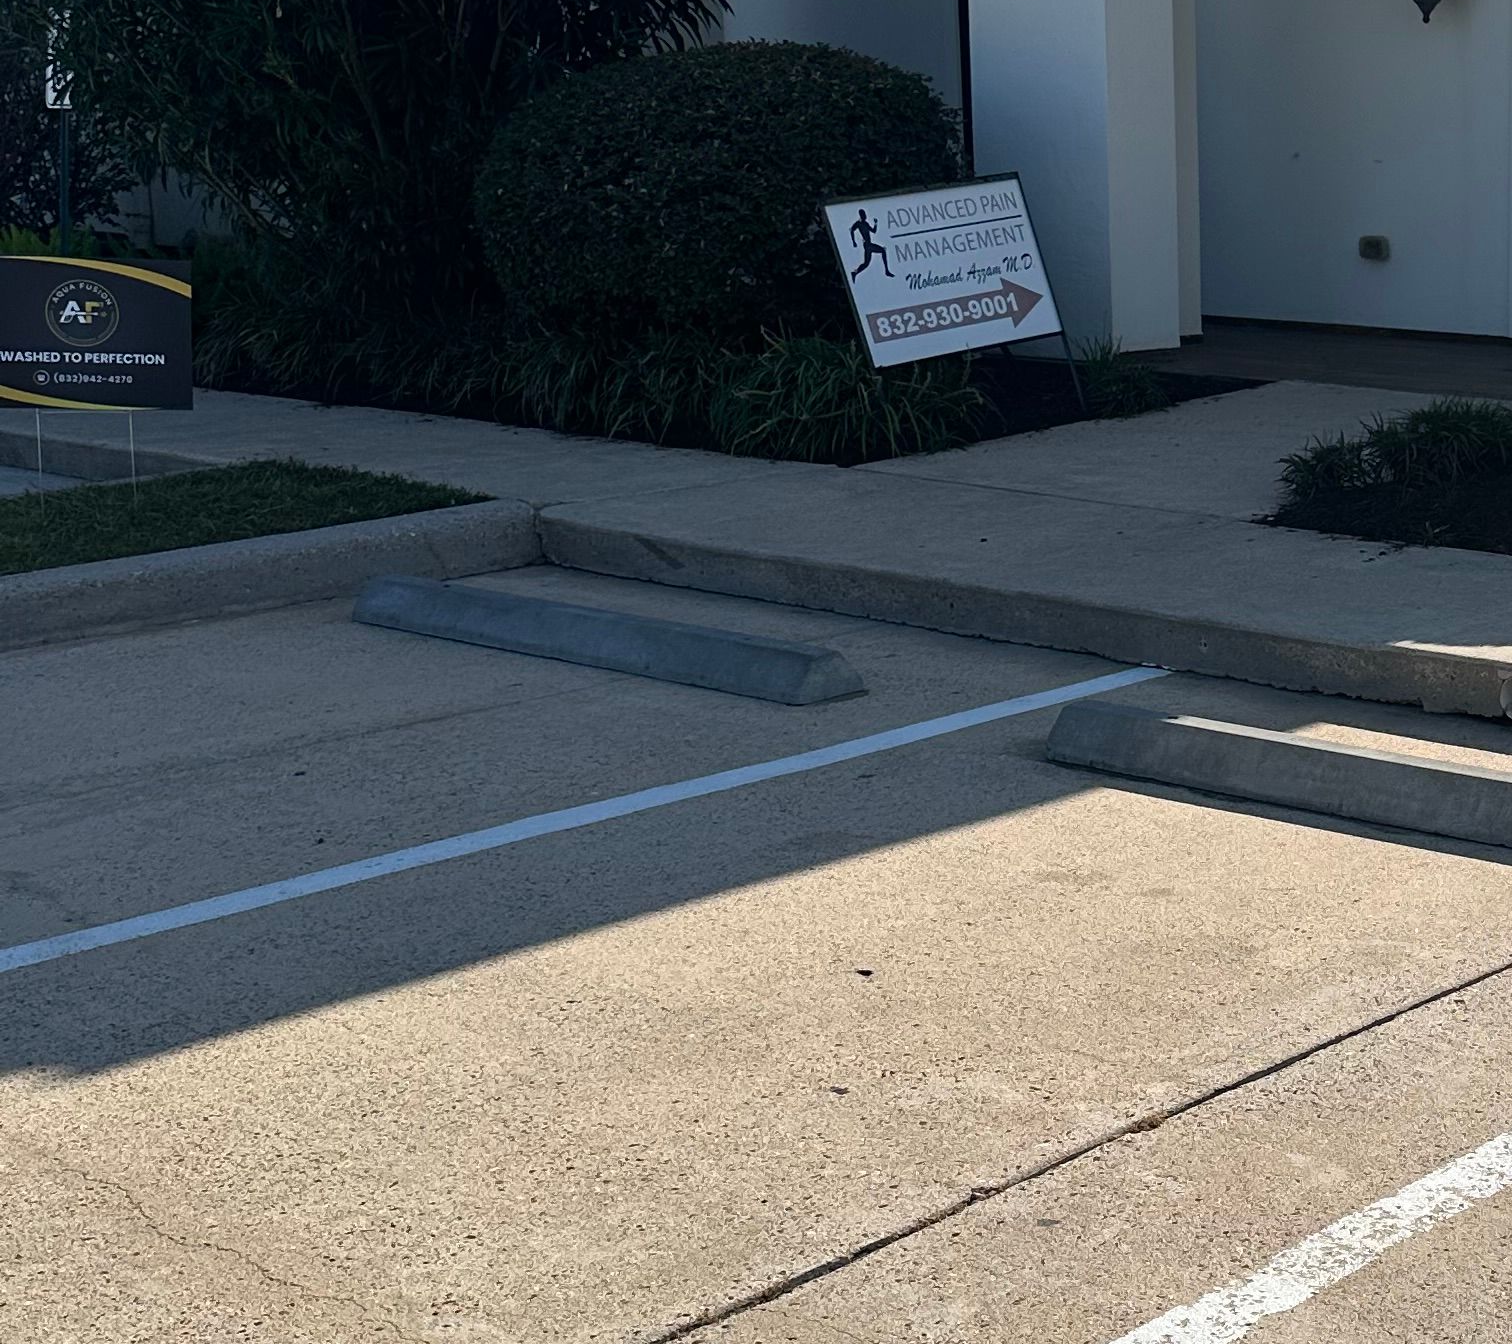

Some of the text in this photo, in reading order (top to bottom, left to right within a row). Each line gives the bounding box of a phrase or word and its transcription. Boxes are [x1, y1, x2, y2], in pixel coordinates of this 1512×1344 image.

[886, 191, 1018, 229] ADVANCED PAIN
[894, 224, 1026, 264] MANAGEMENT
[905, 267, 964, 291] Mohamad
[967, 263, 1002, 285] Azzam
[51, 282, 112, 306] AQUA FUSION
[876, 292, 1019, 338] 832-930-9001
[0, 351, 165, 365] WASHED TO PERFECTION
